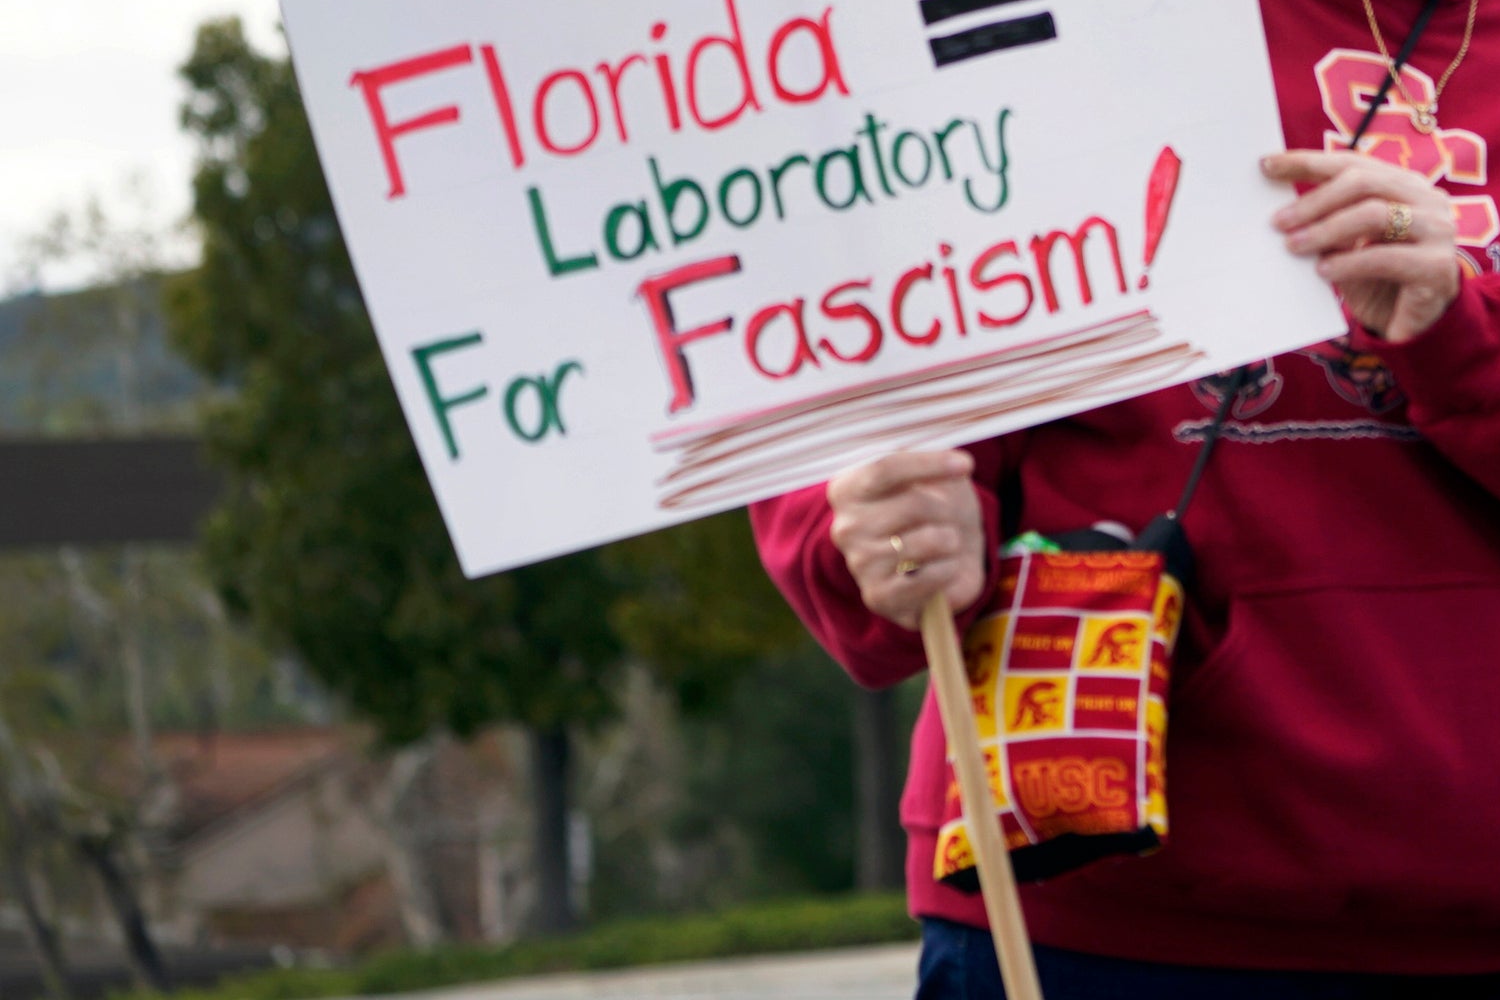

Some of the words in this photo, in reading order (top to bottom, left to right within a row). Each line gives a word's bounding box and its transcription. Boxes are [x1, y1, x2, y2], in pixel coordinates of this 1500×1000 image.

[526, 107, 1014, 277] Laboratory
[636, 145, 1182, 413] Fascism!
[1013, 756, 1128, 817] USC
